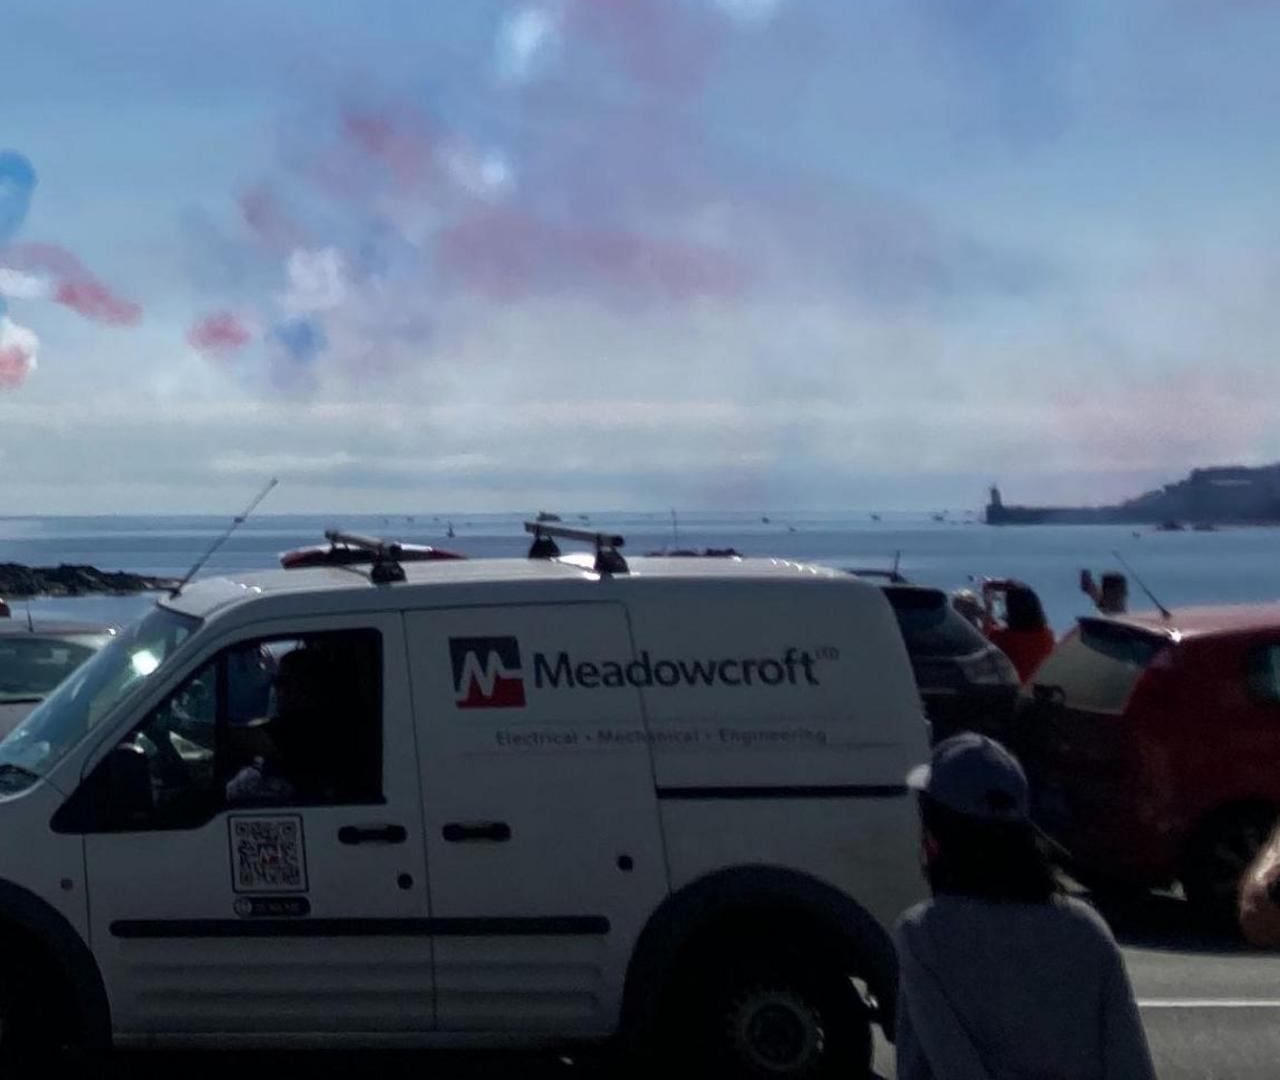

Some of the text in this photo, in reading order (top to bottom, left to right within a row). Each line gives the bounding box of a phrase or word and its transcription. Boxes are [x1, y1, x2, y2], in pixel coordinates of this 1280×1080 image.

[532, 646, 820, 689] Meadowcroft
[496, 727, 827, 747] Electrical Mechanical Engineering
